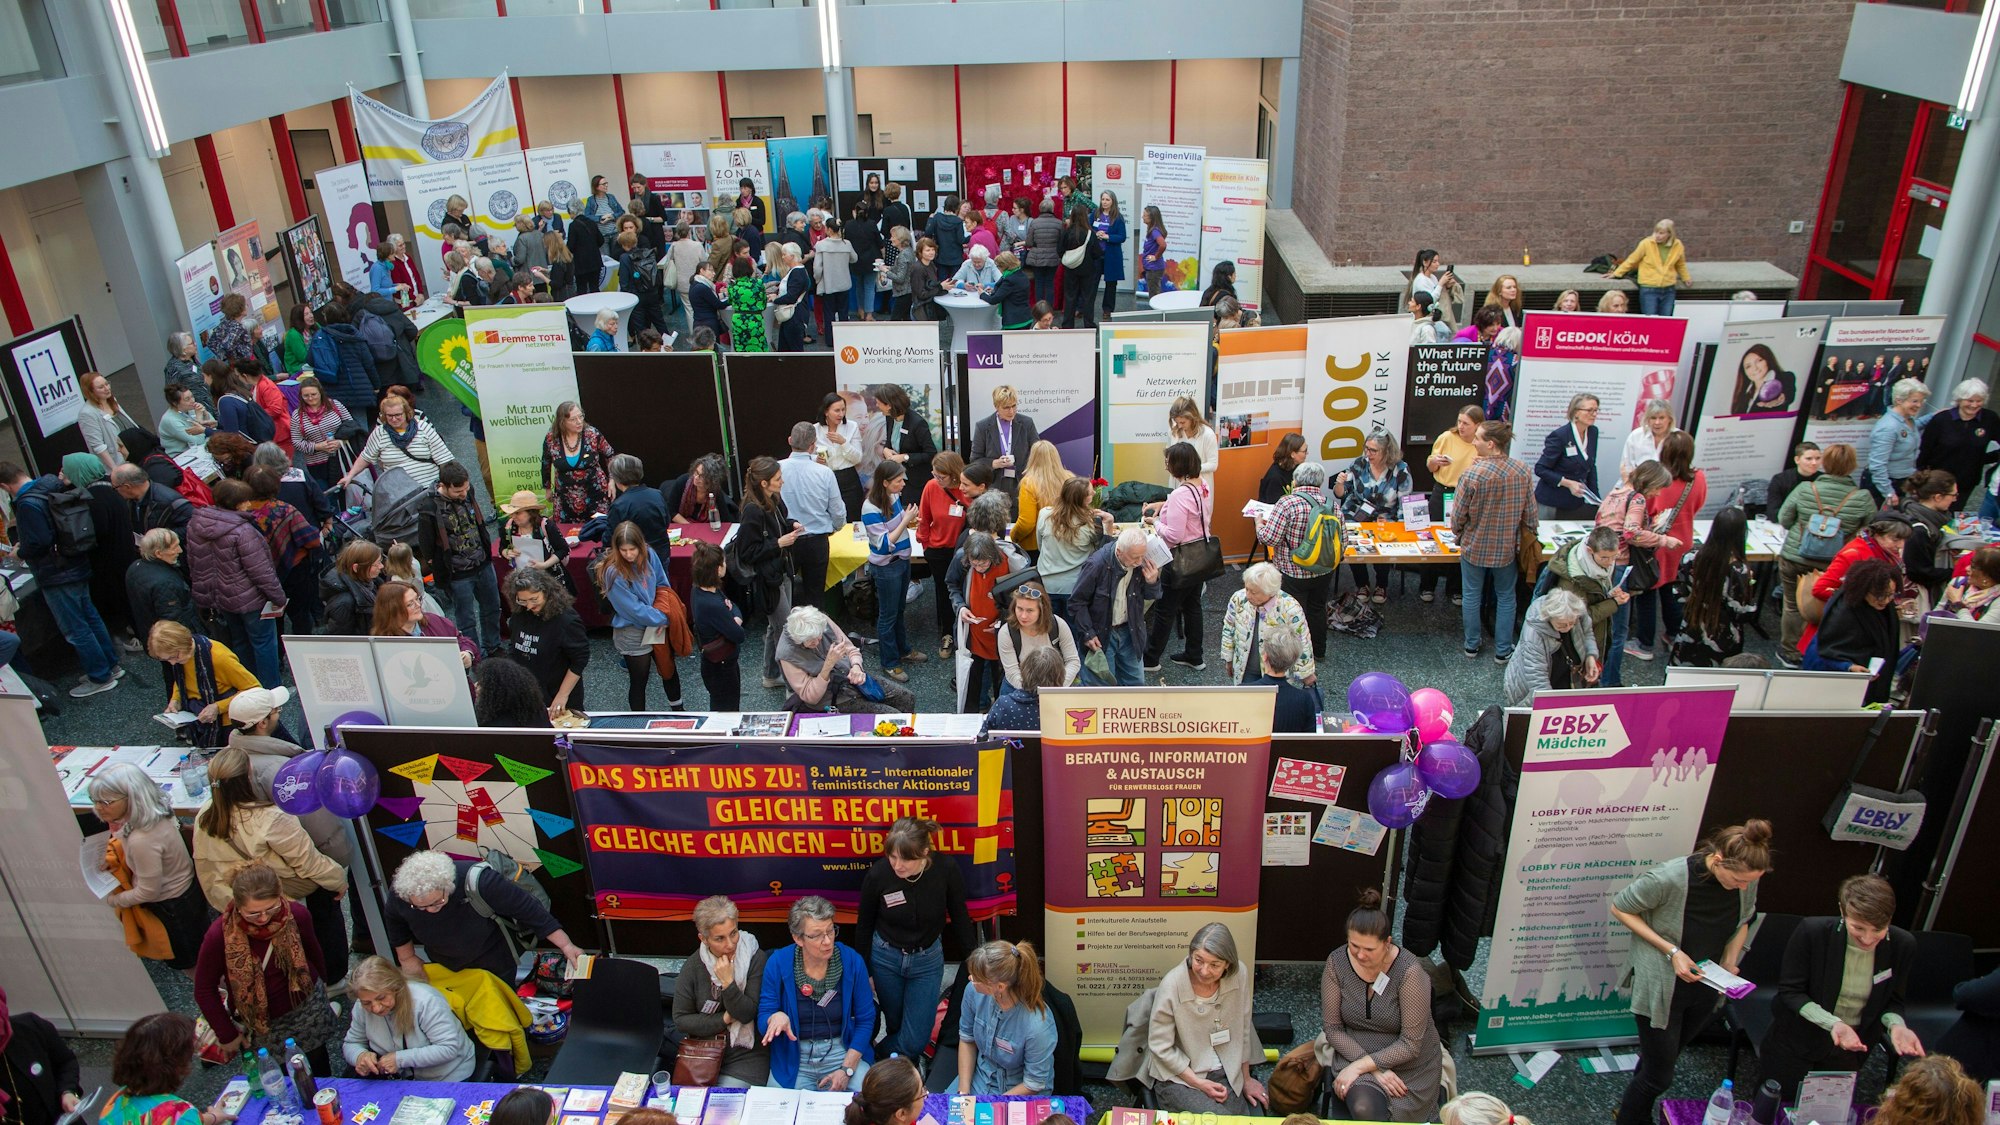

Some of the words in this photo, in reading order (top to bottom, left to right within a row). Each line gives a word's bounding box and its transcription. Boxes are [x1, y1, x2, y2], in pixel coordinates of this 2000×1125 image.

[1148, 150, 1202, 160] BeginenVilla
[470, 164, 495, 172] Soroptimist
[496, 160, 522, 169] International
[543, 158, 571, 167] Deutschland
[407, 172, 432, 180] Soroptimist
[433, 168, 462, 176] International
[483, 168, 511, 176] Deutschland
[716, 169, 762, 179] ZONTA
[1211, 172, 1236, 181] Beginen
[422, 176, 450, 185] Deutschland
[1556, 331, 1607, 343] GEDOK
[1613, 331, 1650, 345] KÖLN
[1875, 335, 1909, 343] erfolgreiche
[862, 347, 902, 357] Working
[904, 347, 934, 355] Moms
[1418, 348, 1453, 359] What
[1456, 348, 1486, 359] IFFF
[976, 353, 1003, 365] VdU
[1137, 354, 1173, 362] Cologne
[1417, 361, 1438, 371] the
[1441, 361, 1481, 371] future
[1146, 377, 1197, 385] Netzwerken
[1416, 373, 1430, 384] of
[1433, 373, 1456, 384] film
[40, 375, 73, 404] FMT
[1136, 389, 1148, 398] für
[1414, 386, 1425, 396] is
[1428, 384, 1478, 396] female?
[1025, 396, 1071, 405] Leidenschaft
[1321, 352, 1371, 460] DOC
[507, 405, 527, 414] Mut
[531, 405, 552, 413] zum
[489, 416, 545, 427] weiblichen
[1103, 707, 1156, 719] FRAUEN
[1103, 722, 1239, 734] ERWERBSLOSIGKEIT
[1536, 736, 1607, 750] Mädchen
[1065, 752, 1145, 766] BERATUNG,
[1150, 752, 1248, 764] INFORMATION
[579, 765, 625, 789] DAS
[632, 767, 700, 789] STEHT
[709, 767, 757, 789] UNS
[764, 767, 802, 789] ZU:
[810, 767, 824, 778] 8.
[829, 765, 867, 777] März
[884, 766, 974, 777] Internationaler
[1106, 769, 1117, 780] &
[1121, 768, 1205, 779] AUSTAUSCH
[812, 779, 899, 790] feministischer
[902, 780, 971, 791] Aktionstag
[715, 798, 824, 823] GLEICHE
[833, 799, 938, 823] RECHTE,
[1532, 809, 1568, 817] LOBBY
[1595, 805, 1649, 814] MÄDCHEN
[1588, 816, 1649, 824] Mädcheninteressen
[1588, 832, 1653, 841] (Fach-)Öffentlichkeit
[1844, 824, 1906, 840] Mädchen
[594, 827, 696, 854] GLEICHE
[704, 831, 826, 855] CHANCEN
[1522, 864, 1557, 872] LOBBY
[1560, 862, 1581, 870] FÜR
[1584, 860, 1636, 869] MÄDCHEN
[1528, 874, 1634, 883] Mädchenberatungsstelle
[1519, 922, 1592, 931] Mädchenzentrum
[1517, 932, 1590, 942] Mädchenzentrum
